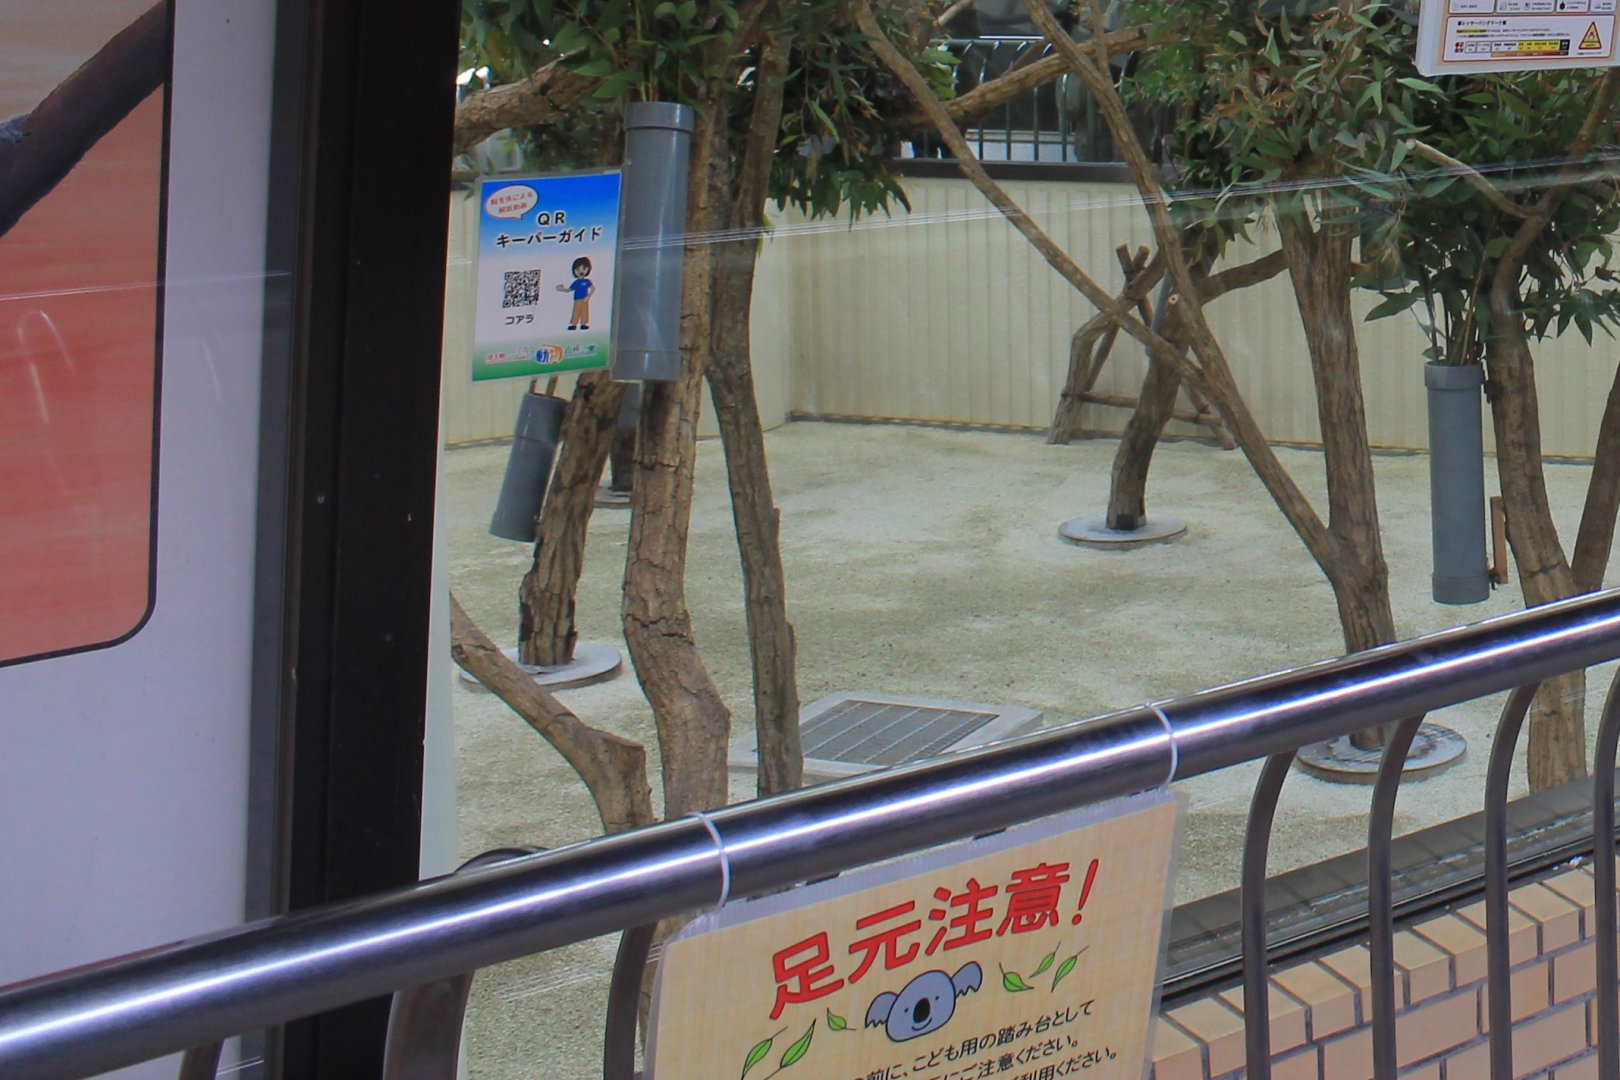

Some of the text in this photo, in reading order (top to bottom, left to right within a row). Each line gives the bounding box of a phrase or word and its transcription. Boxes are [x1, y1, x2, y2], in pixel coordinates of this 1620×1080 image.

[537, 211, 566, 226] QR
[505, 314, 535, 326] コアラ
[768, 857, 1101, 1021] 足元注意!
